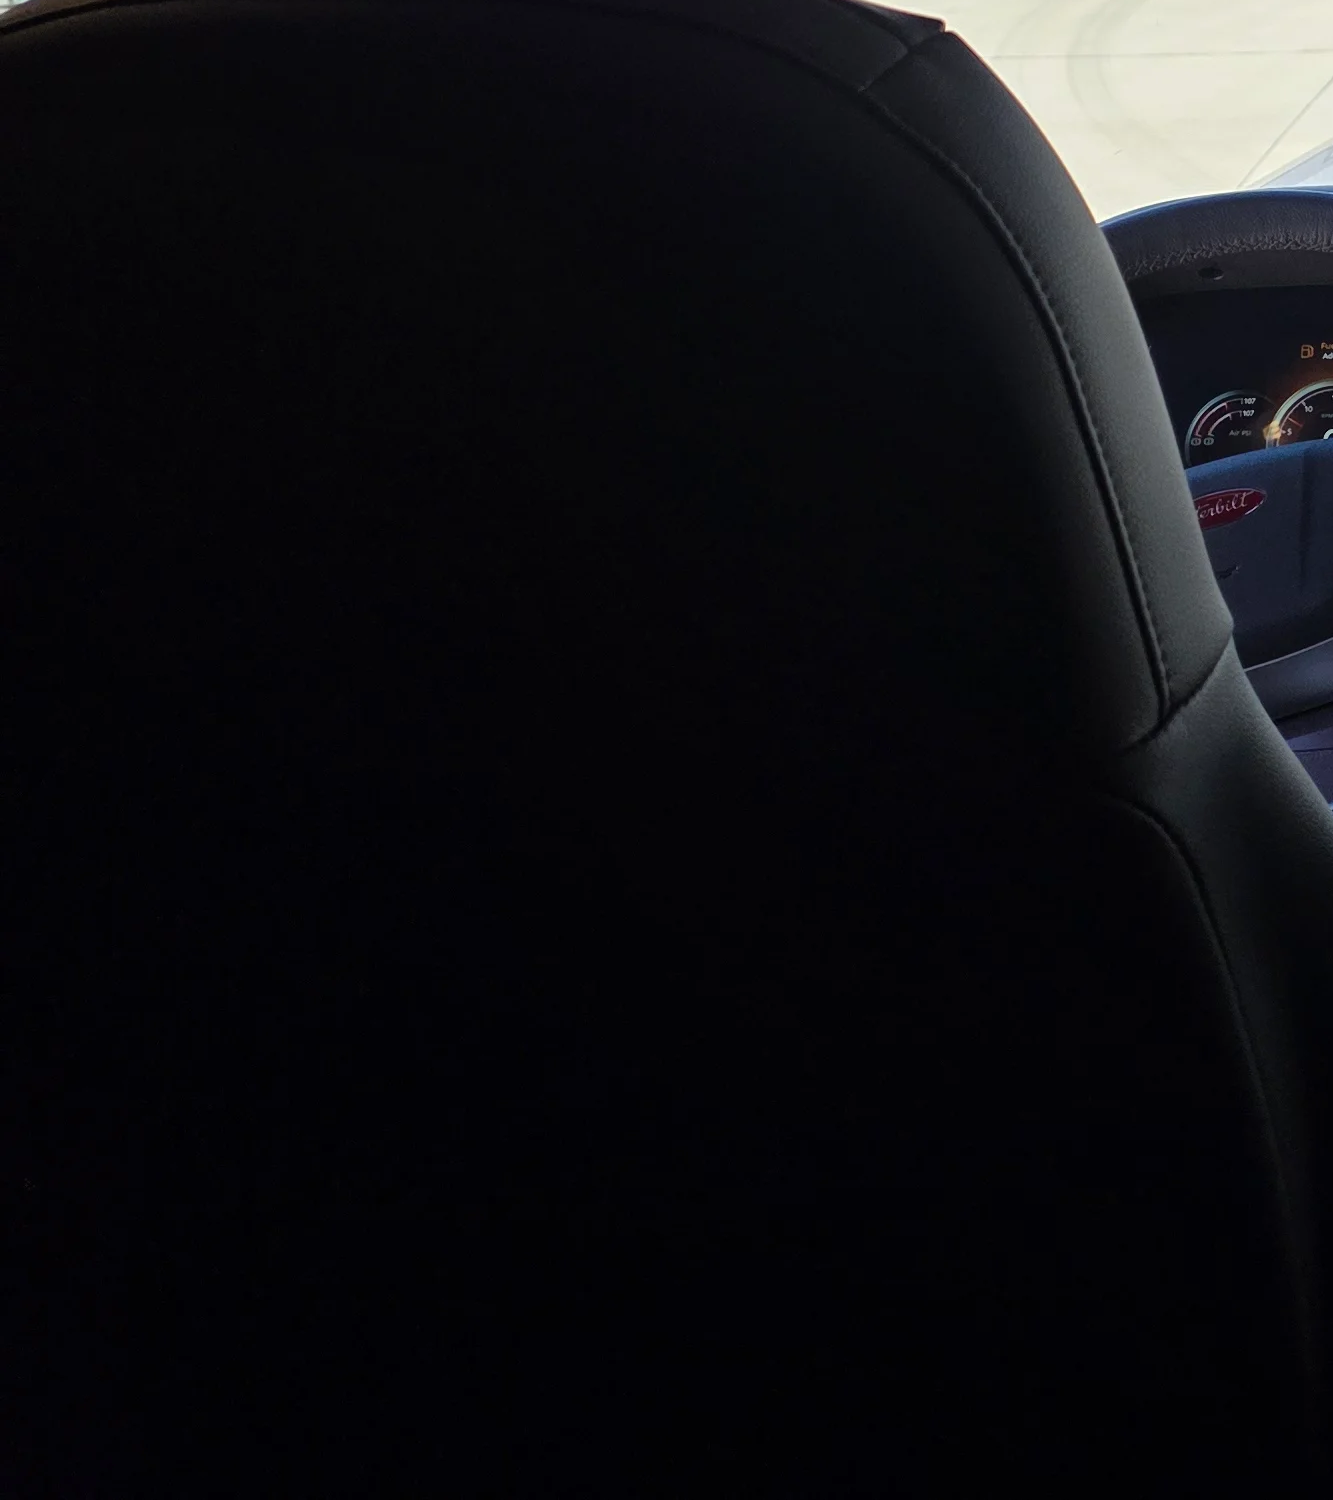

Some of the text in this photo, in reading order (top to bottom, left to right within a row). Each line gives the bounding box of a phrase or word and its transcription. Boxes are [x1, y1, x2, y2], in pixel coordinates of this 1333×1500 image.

[1305, 405, 1314, 413] 10
[1287, 428, 1293, 436] 5
[1197, 490, 1255, 519] terbilt
